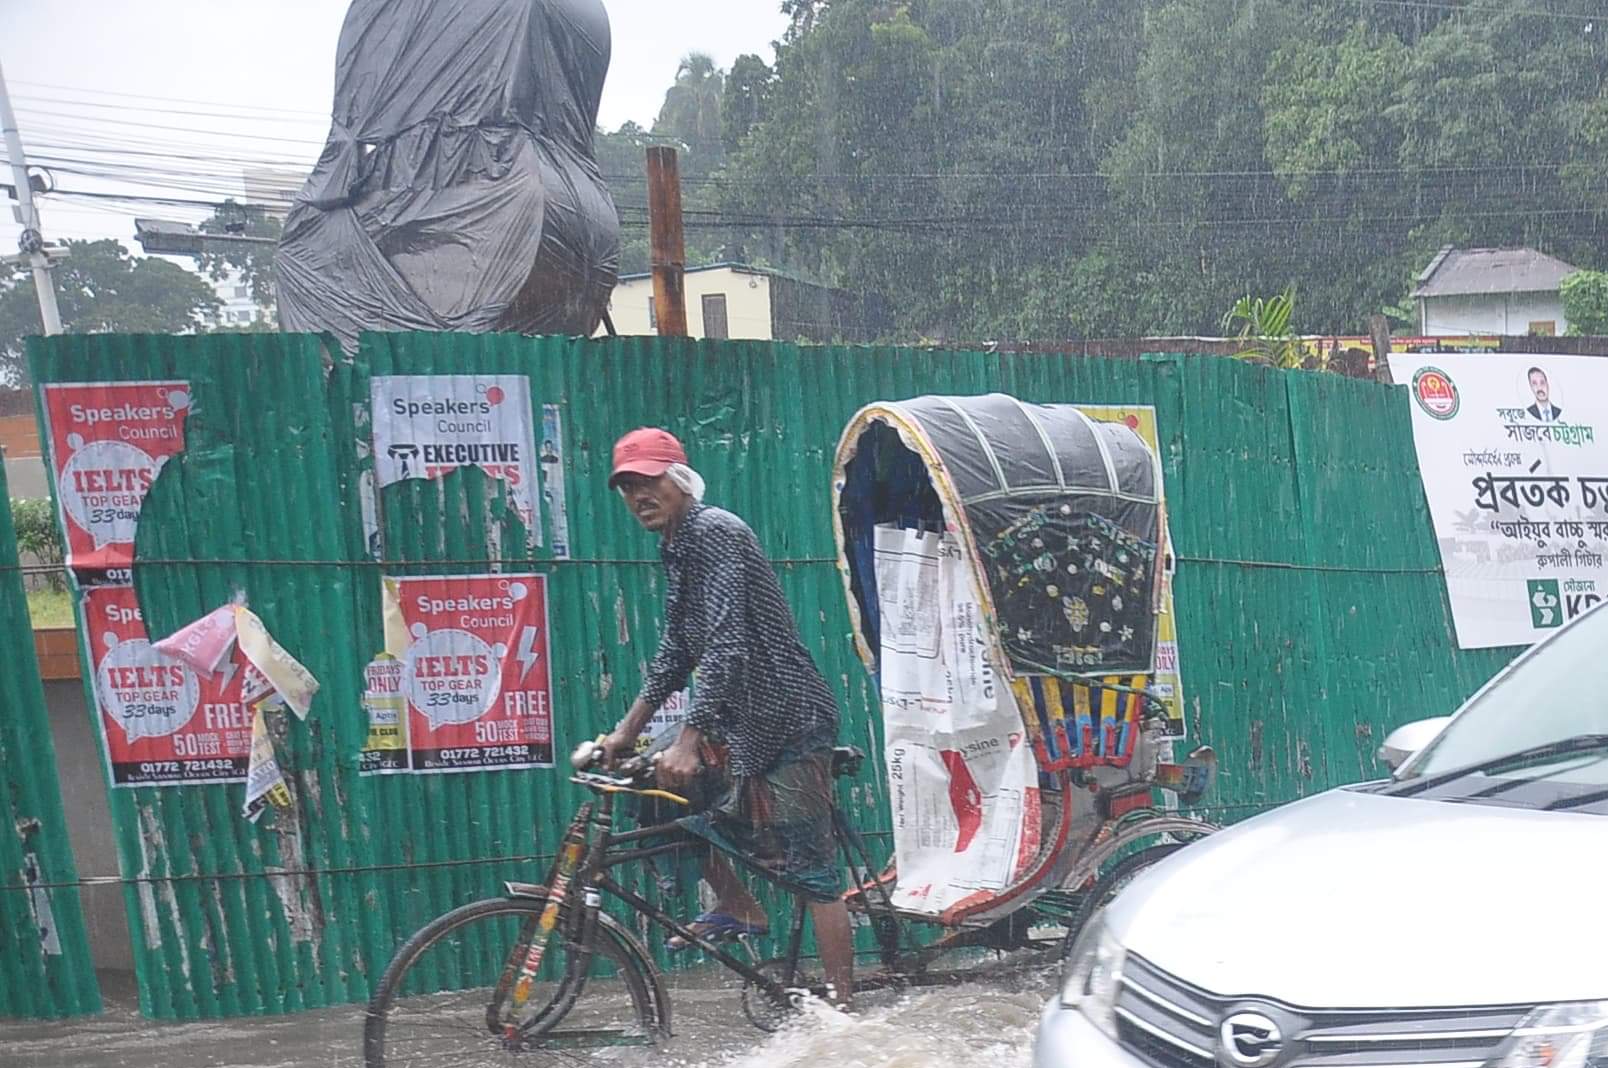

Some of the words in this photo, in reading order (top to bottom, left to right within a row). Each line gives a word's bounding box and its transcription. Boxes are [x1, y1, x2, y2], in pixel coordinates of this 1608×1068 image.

[70, 403, 175, 426] Speakers
[393, 398, 490, 418] Speakers
[118, 425, 178, 440] Council
[437, 420, 492, 433] Council
[1504, 421, 1551, 442] সাজবে
[1551, 421, 1594, 447] চট্টগ্রাম
[423, 443, 520, 463] EXECUTIVE
[72, 468, 152, 493] IELTS
[1472, 459, 1570, 513] প্রবর্তক
[82, 495, 109, 507] TOP
[90, 509, 116, 523] 33
[1574, 549, 1603, 569] গিটার
[417, 595, 513, 615] Speakers
[460, 615, 514, 628] Council
[107, 664, 184, 689] IELTS
[415, 655, 488, 678] IELTS
[368, 676, 400, 693] ONLY
[422, 679, 445, 691] TOP
[448, 679, 483, 690] GEAR
[116, 690, 142, 703] TOP
[144, 690, 179, 702] GEAR
[427, 693, 451, 706] 33
[452, 693, 479, 705] days
[504, 690, 547, 716] FREE
[122, 703, 146, 719] 33
[147, 701, 176, 717] days
[203, 703, 254, 730] FREE
[475, 720, 497, 742] 50
[497, 728, 519, 742] TEST
[173, 733, 198, 756] 50
[198, 741, 221, 755] TEST
[440, 749, 480, 760] 01772
[483, 745, 529, 758] 721432
[140, 762, 180, 773] 01772
[183, 759, 233, 771] 721432
[891, 748, 905, 780] 25kg
